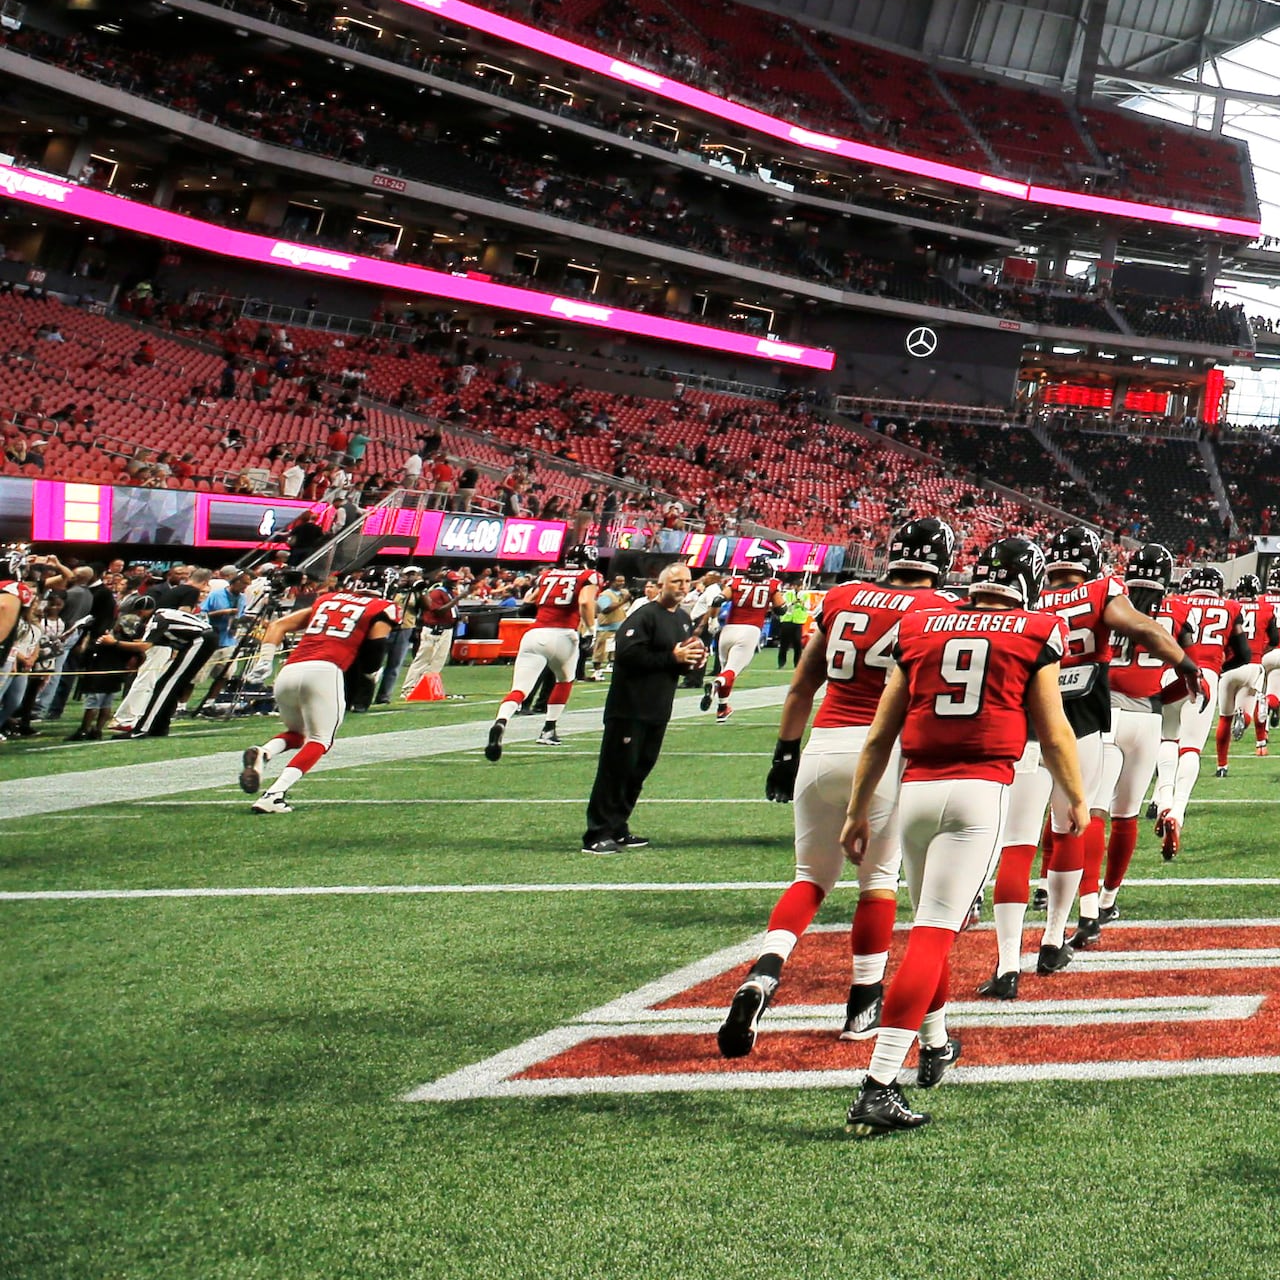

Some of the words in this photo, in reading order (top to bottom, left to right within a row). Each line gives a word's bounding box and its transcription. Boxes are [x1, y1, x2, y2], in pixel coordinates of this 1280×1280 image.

[373, 176, 405, 191] 241-242
[443, 518, 501, 551] 44:08
[504, 523, 531, 554] 1ST
[538, 529, 559, 554] QTR
[903, 546, 920, 559] 64
[1053, 549, 1070, 560] 95
[988, 571, 996, 582] 9
[539, 576, 577, 606] 73
[737, 585, 770, 608] 70
[851, 590, 916, 612] HARLOW
[1187, 598, 1225, 607] PERKINS
[306, 601, 366, 638] 63
[923, 613, 1027, 634] TORGERSEN
[1055, 603, 1096, 658] 5
[826, 611, 900, 685] 64
[934, 638, 990, 716] 9
[1059, 673, 1081, 687] GLAS
